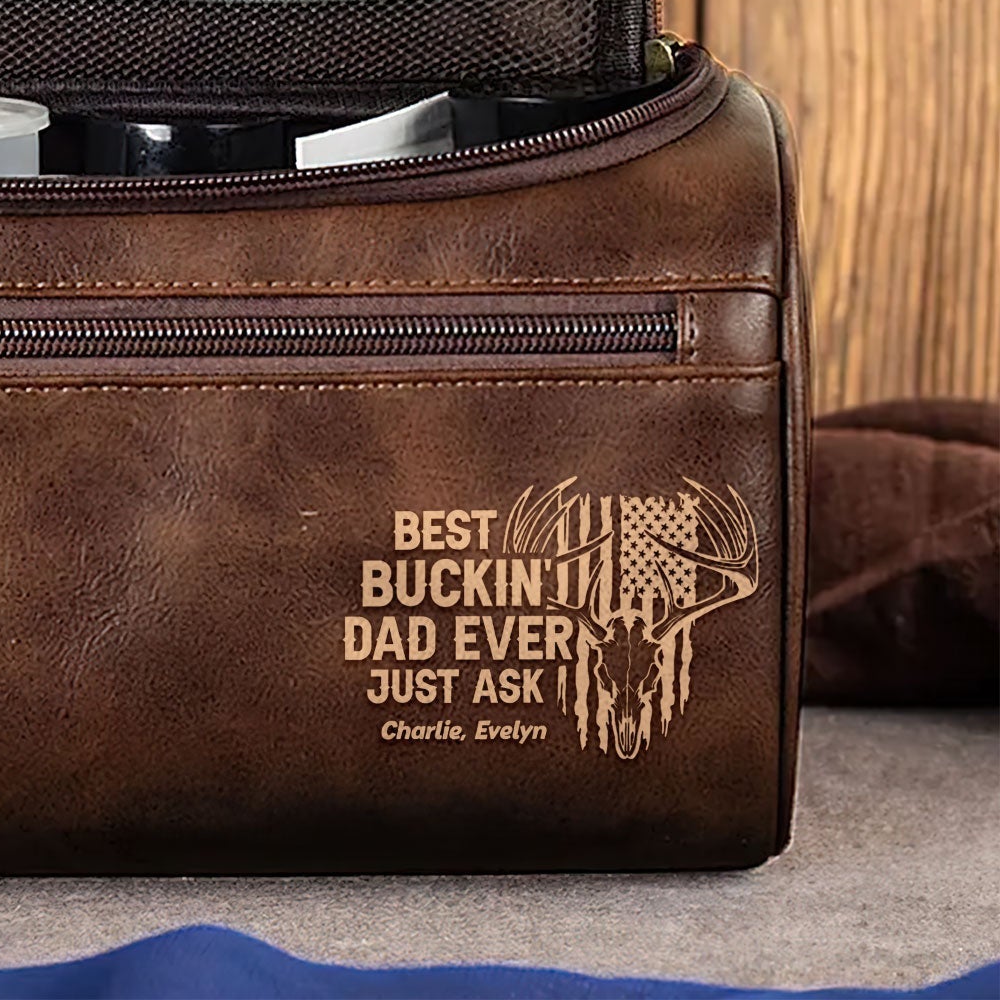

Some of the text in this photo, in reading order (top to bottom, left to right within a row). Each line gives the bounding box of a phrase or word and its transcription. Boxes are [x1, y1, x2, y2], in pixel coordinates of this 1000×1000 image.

[394, 509, 497, 550] BEST
[361, 558, 552, 607] BUCKIN'
[342, 616, 573, 661] DAD EVER
[366, 668, 544, 704] JUST ASK
[381, 720, 547, 744] Charlie, Evelyn
